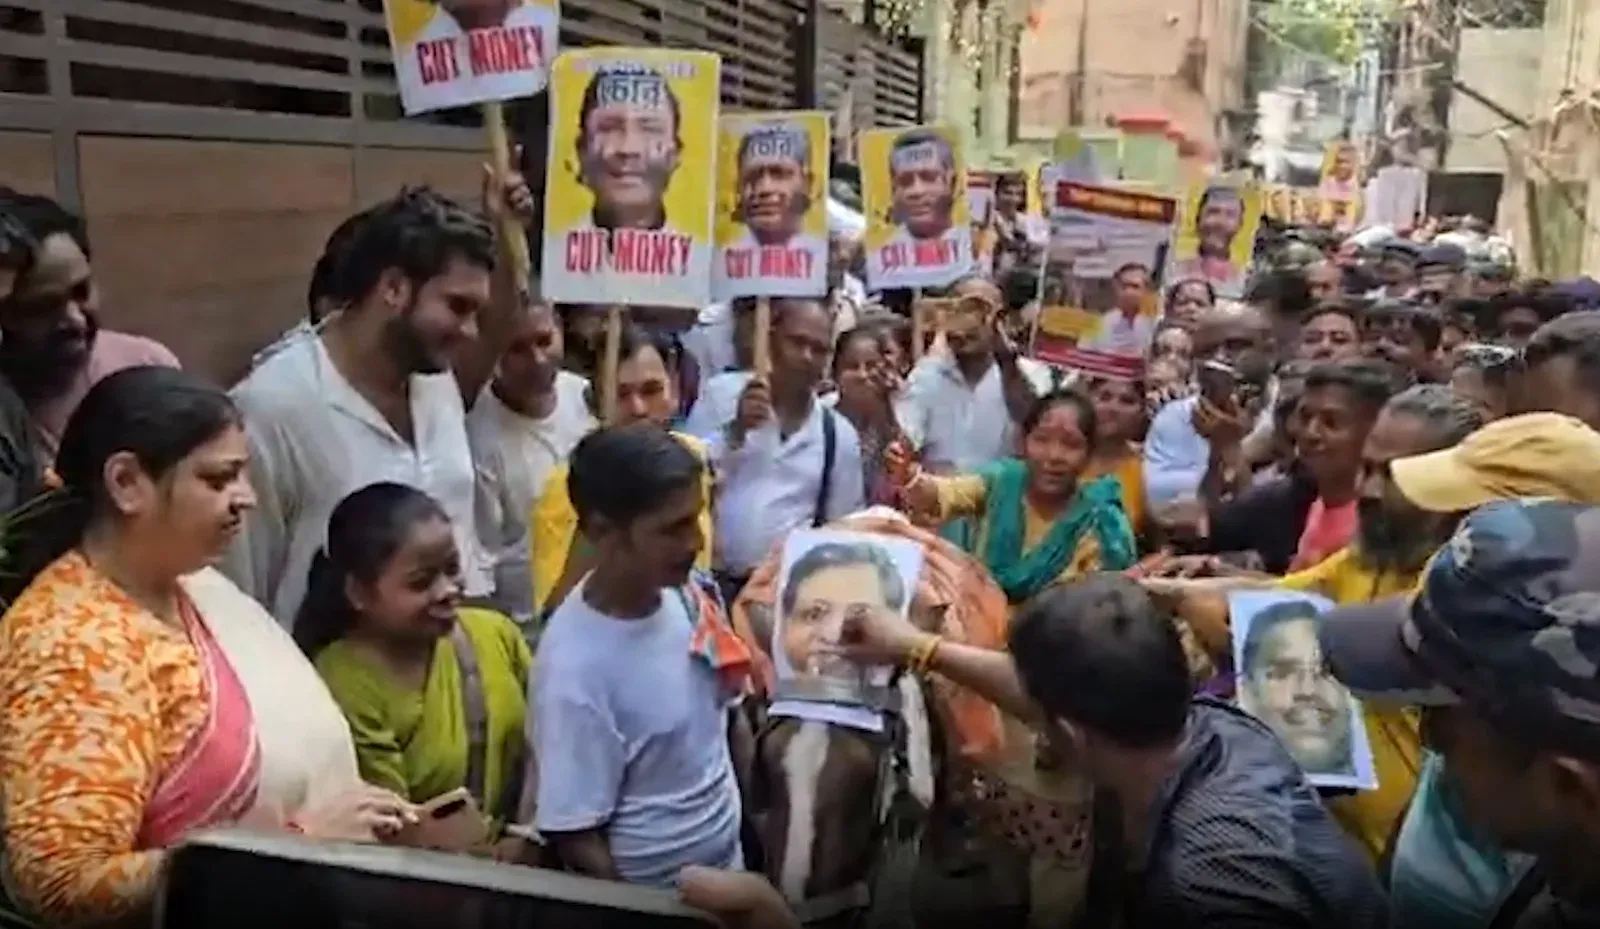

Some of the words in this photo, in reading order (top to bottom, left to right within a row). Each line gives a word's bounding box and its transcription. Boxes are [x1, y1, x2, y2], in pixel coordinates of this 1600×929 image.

[416, 40, 461, 85] CUT
[470, 26, 544, 78] MONEY
[565, 228, 608, 275] CUT
[615, 230, 692, 277] MONEY
[724, 246, 754, 279] CUT
[760, 247, 814, 279] MONEY
